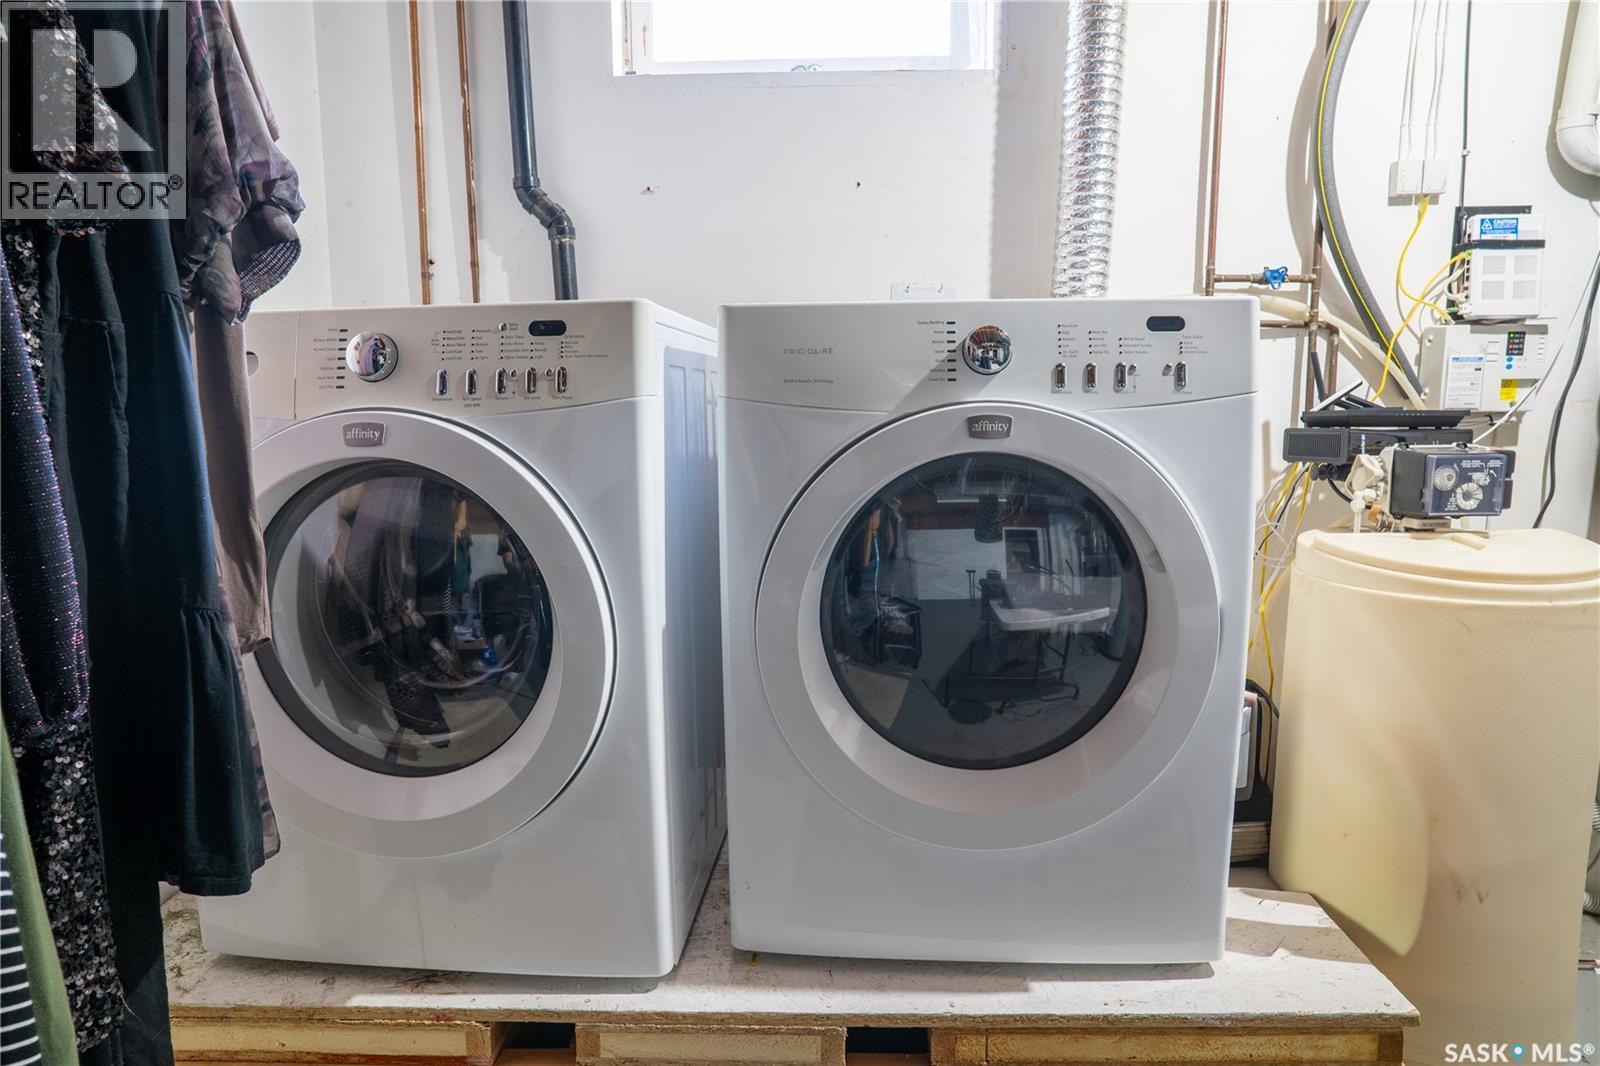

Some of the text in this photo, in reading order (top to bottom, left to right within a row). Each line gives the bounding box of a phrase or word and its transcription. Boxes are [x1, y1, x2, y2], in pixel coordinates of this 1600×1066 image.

[784, 347, 833, 356] FRIGIDAIRE
[972, 420, 1009, 433] affinity
[346, 428, 380, 441] affinity
